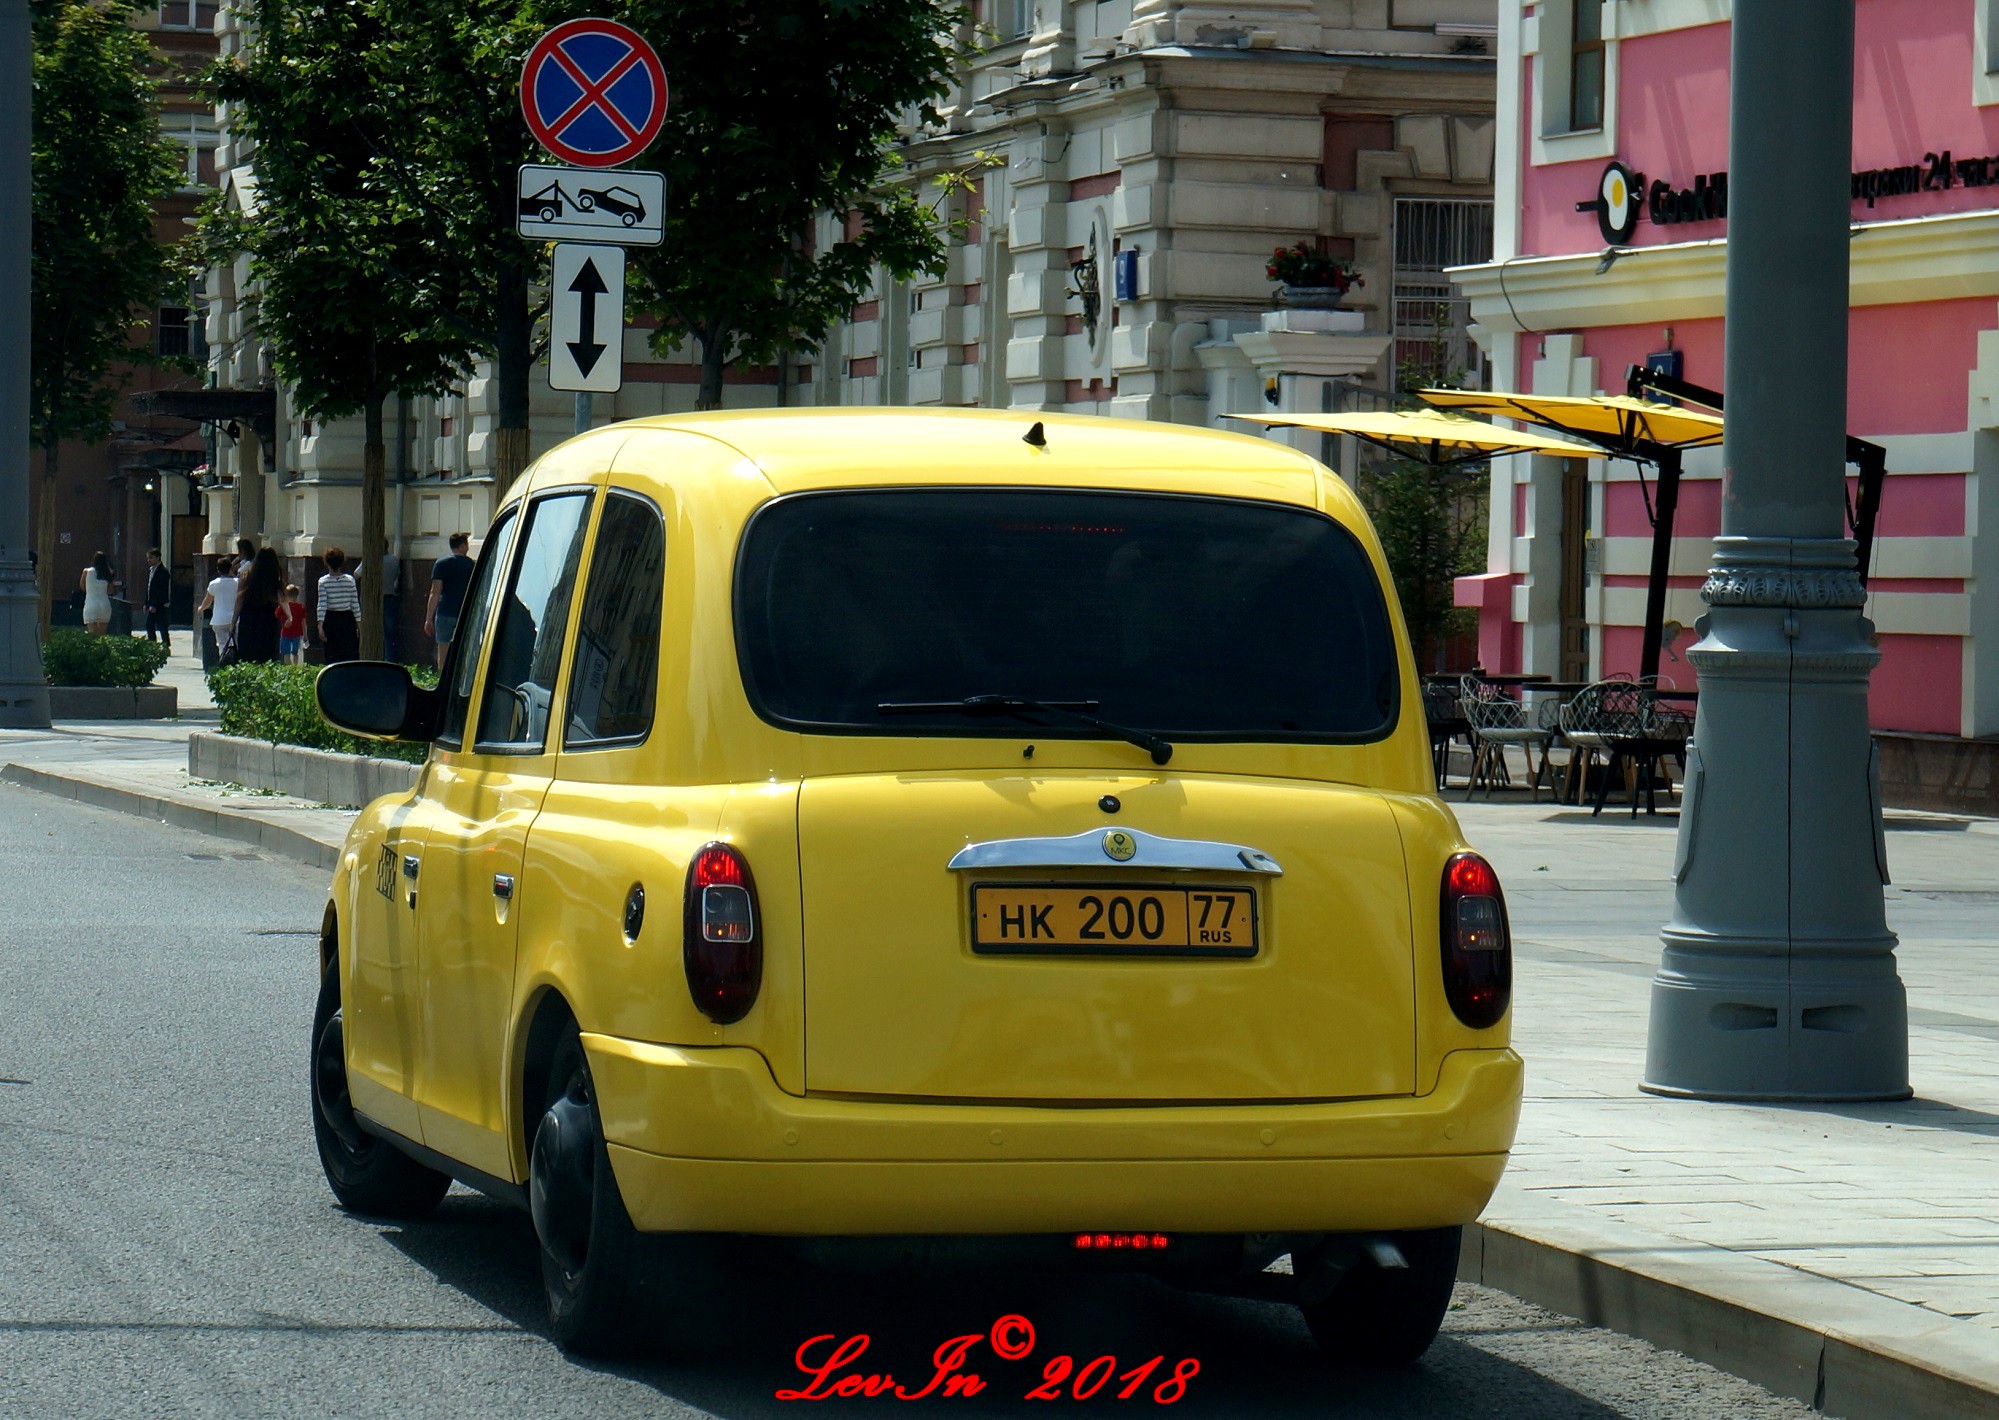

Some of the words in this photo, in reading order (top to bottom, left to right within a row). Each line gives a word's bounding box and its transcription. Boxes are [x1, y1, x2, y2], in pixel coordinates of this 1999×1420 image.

[1923, 150, 1951, 192] 24
[1000, 904, 1055, 939] HK
[1078, 895, 1164, 940] 200
[1193, 895, 1235, 928] 77
[1200, 930, 1232, 943] RUS
